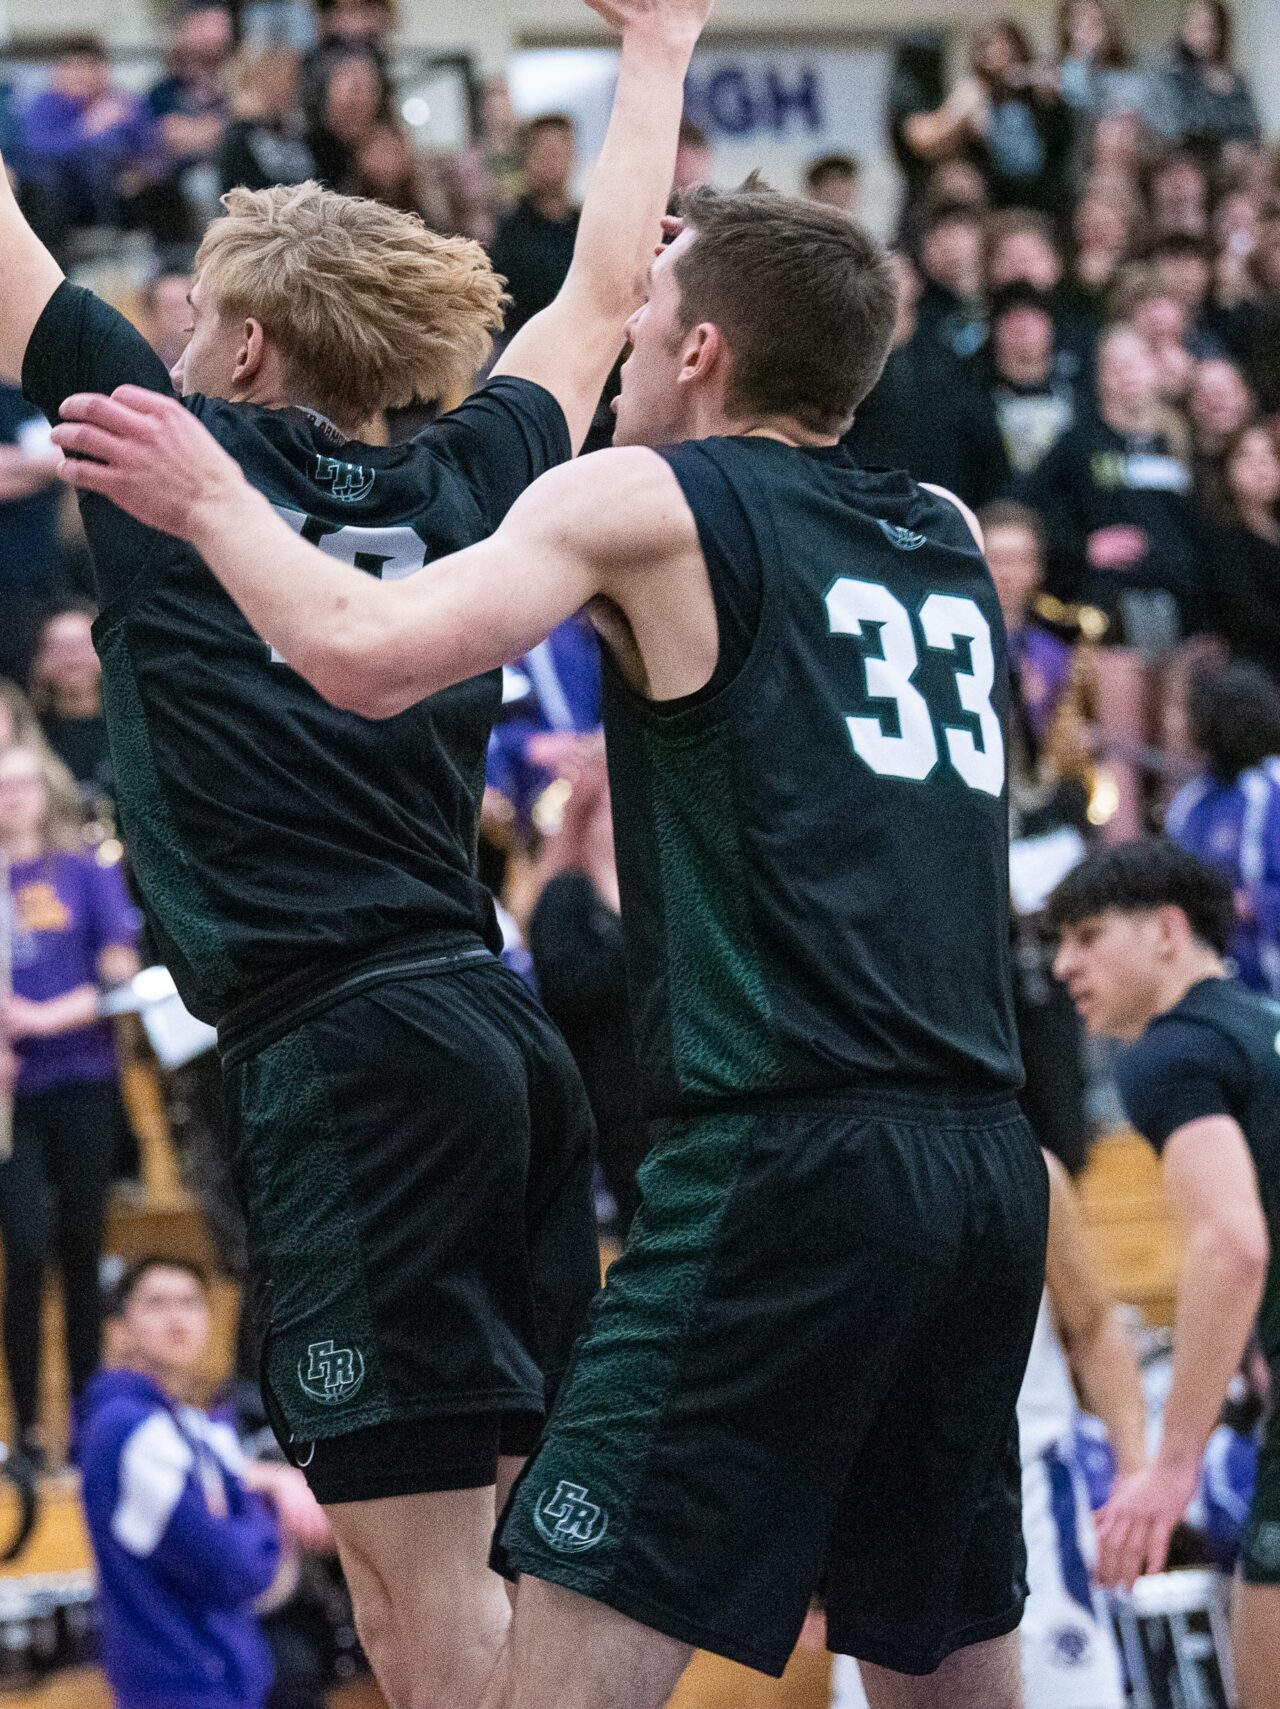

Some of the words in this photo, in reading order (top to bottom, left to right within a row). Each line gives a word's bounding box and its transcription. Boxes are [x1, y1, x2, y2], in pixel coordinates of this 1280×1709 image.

[823, 576, 1006, 798] 33
[307, 1339, 355, 1389] FR
[543, 1480, 601, 1540] FR
